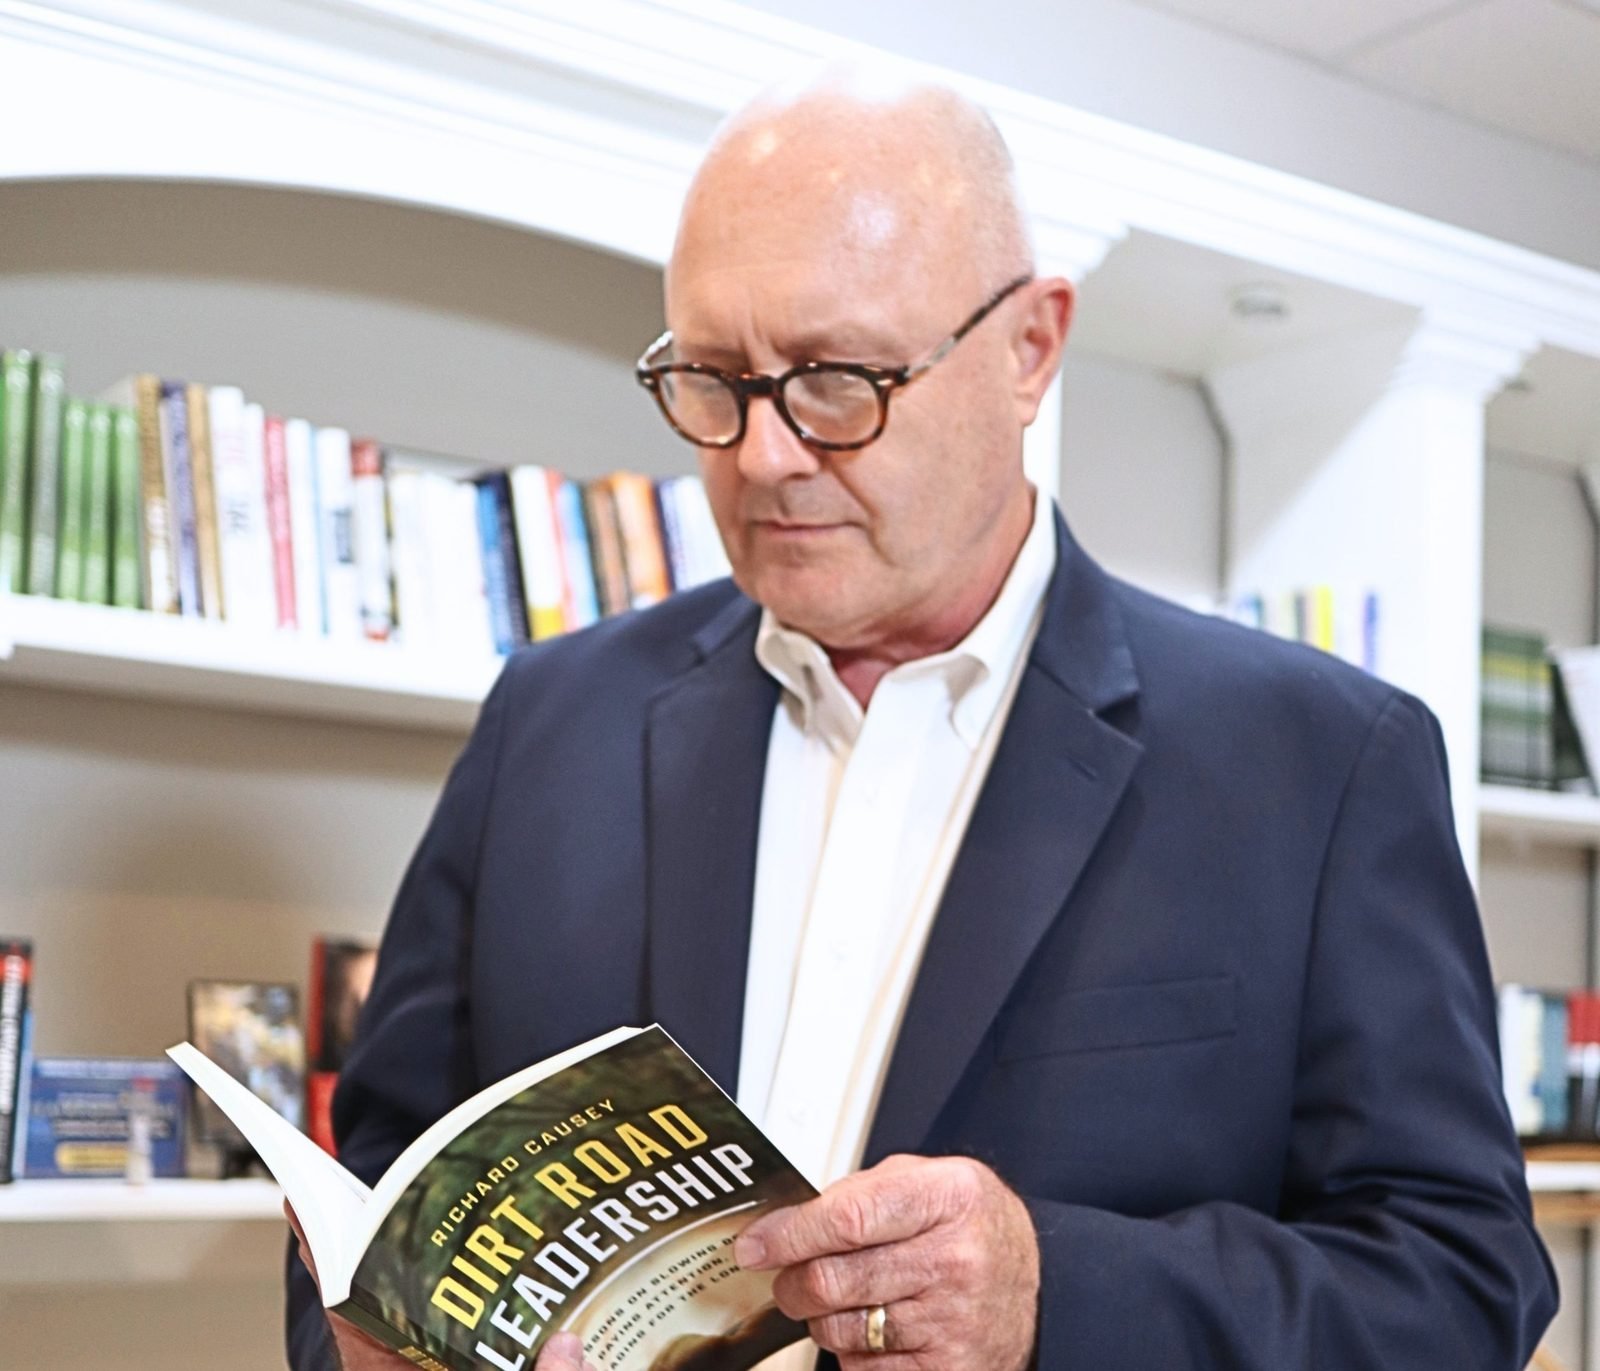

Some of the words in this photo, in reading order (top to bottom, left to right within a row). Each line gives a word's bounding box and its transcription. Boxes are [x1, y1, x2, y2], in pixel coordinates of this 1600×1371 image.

[430, 1155, 520, 1247] RICHARD
[524, 1098, 615, 1156] CAUSEY
[431, 1194, 545, 1331] DIRT
[534, 1104, 709, 1209] ROAD
[475, 1143, 754, 1371] LEADERSHIP
[610, 1329, 646, 1371] ADING
[648, 1303, 675, 1327] FOR
[678, 1283, 706, 1302] THE
[709, 1264, 741, 1284] LON
[584, 1307, 625, 1353] SSONS
[598, 1313, 641, 1361] PAYING
